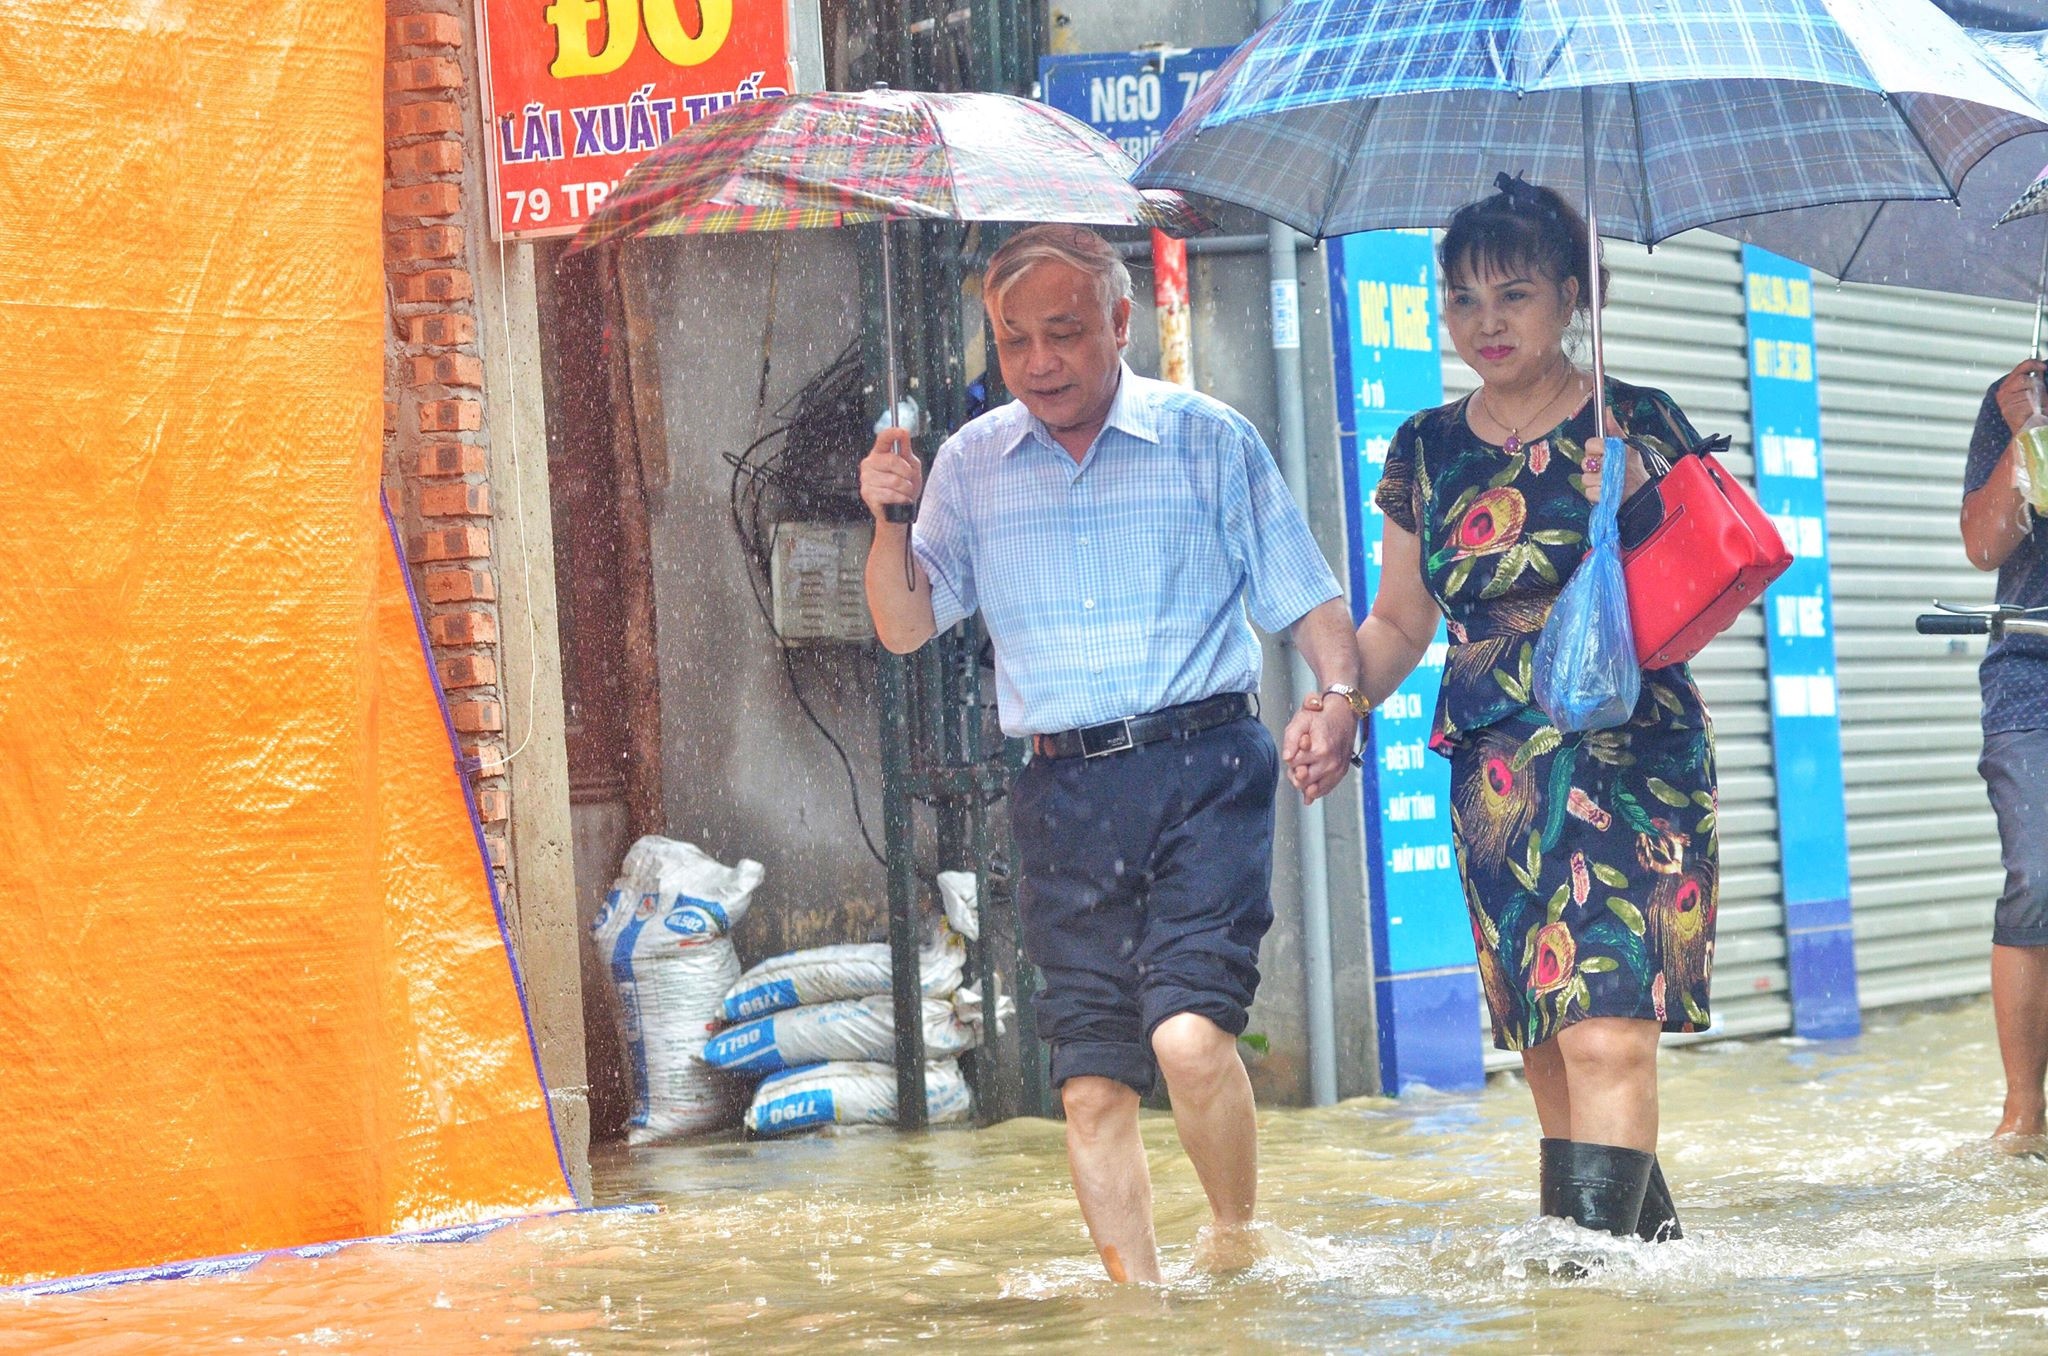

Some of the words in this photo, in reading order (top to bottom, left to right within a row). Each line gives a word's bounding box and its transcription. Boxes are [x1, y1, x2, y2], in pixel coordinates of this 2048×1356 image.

[500, 101, 565, 165] LÃI
[570, 83, 677, 158] XUẤT
[506, 187, 551, 224] 79
[717, 1029, 760, 1056] 7790
